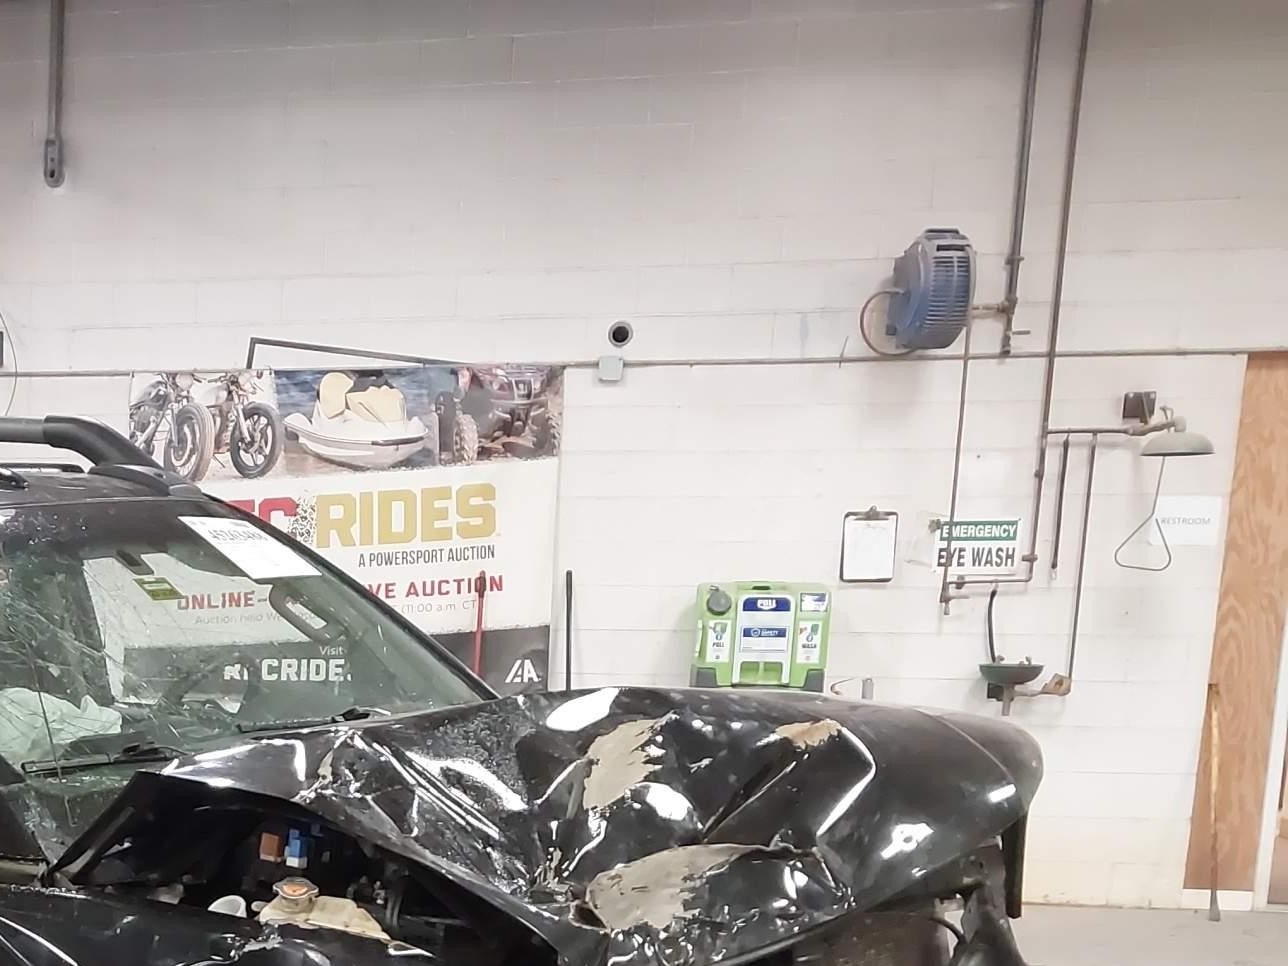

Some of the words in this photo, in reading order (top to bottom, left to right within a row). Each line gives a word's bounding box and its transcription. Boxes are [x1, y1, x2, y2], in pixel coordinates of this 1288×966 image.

[316, 482, 497, 549] RIDES
[941, 524, 1017, 538] EMERGENCY
[358, 553, 366, 568] A
[369, 548, 444, 567] POWERSPORT
[447, 545, 495, 563] AUCTION
[971, 546, 1016, 567] WASH
[405, 575, 504, 598] AUCTION
[319, 645, 344, 656] Visit
